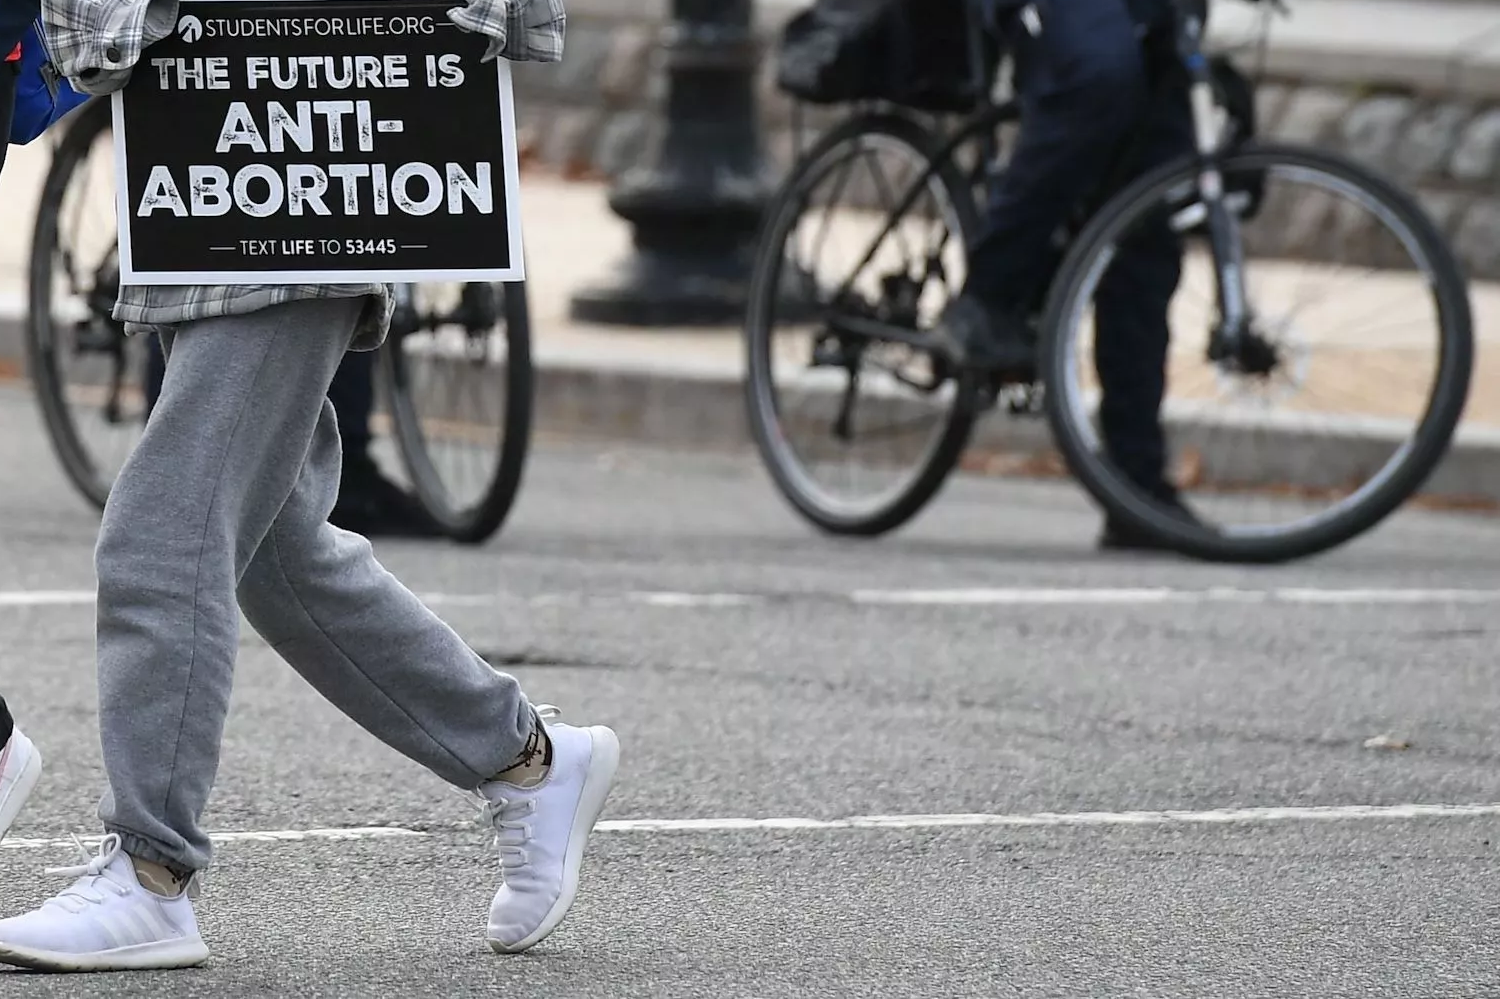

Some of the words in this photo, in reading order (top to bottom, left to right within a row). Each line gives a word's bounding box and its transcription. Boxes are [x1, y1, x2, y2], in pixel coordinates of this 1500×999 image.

[205, 16, 435, 37] STUDENTSFORLIFE.ORG
[151, 56, 231, 90] THE
[246, 54, 410, 90] FUTURE
[425, 53, 465, 88] IS
[215, 100, 404, 153] ANTI-
[137, 162, 494, 218] ABORTION
[239, 240, 278, 256] TEXT
[281, 240, 315, 256] LIFE
[319, 239, 341, 255] TO
[345, 238, 397, 255] 53445
